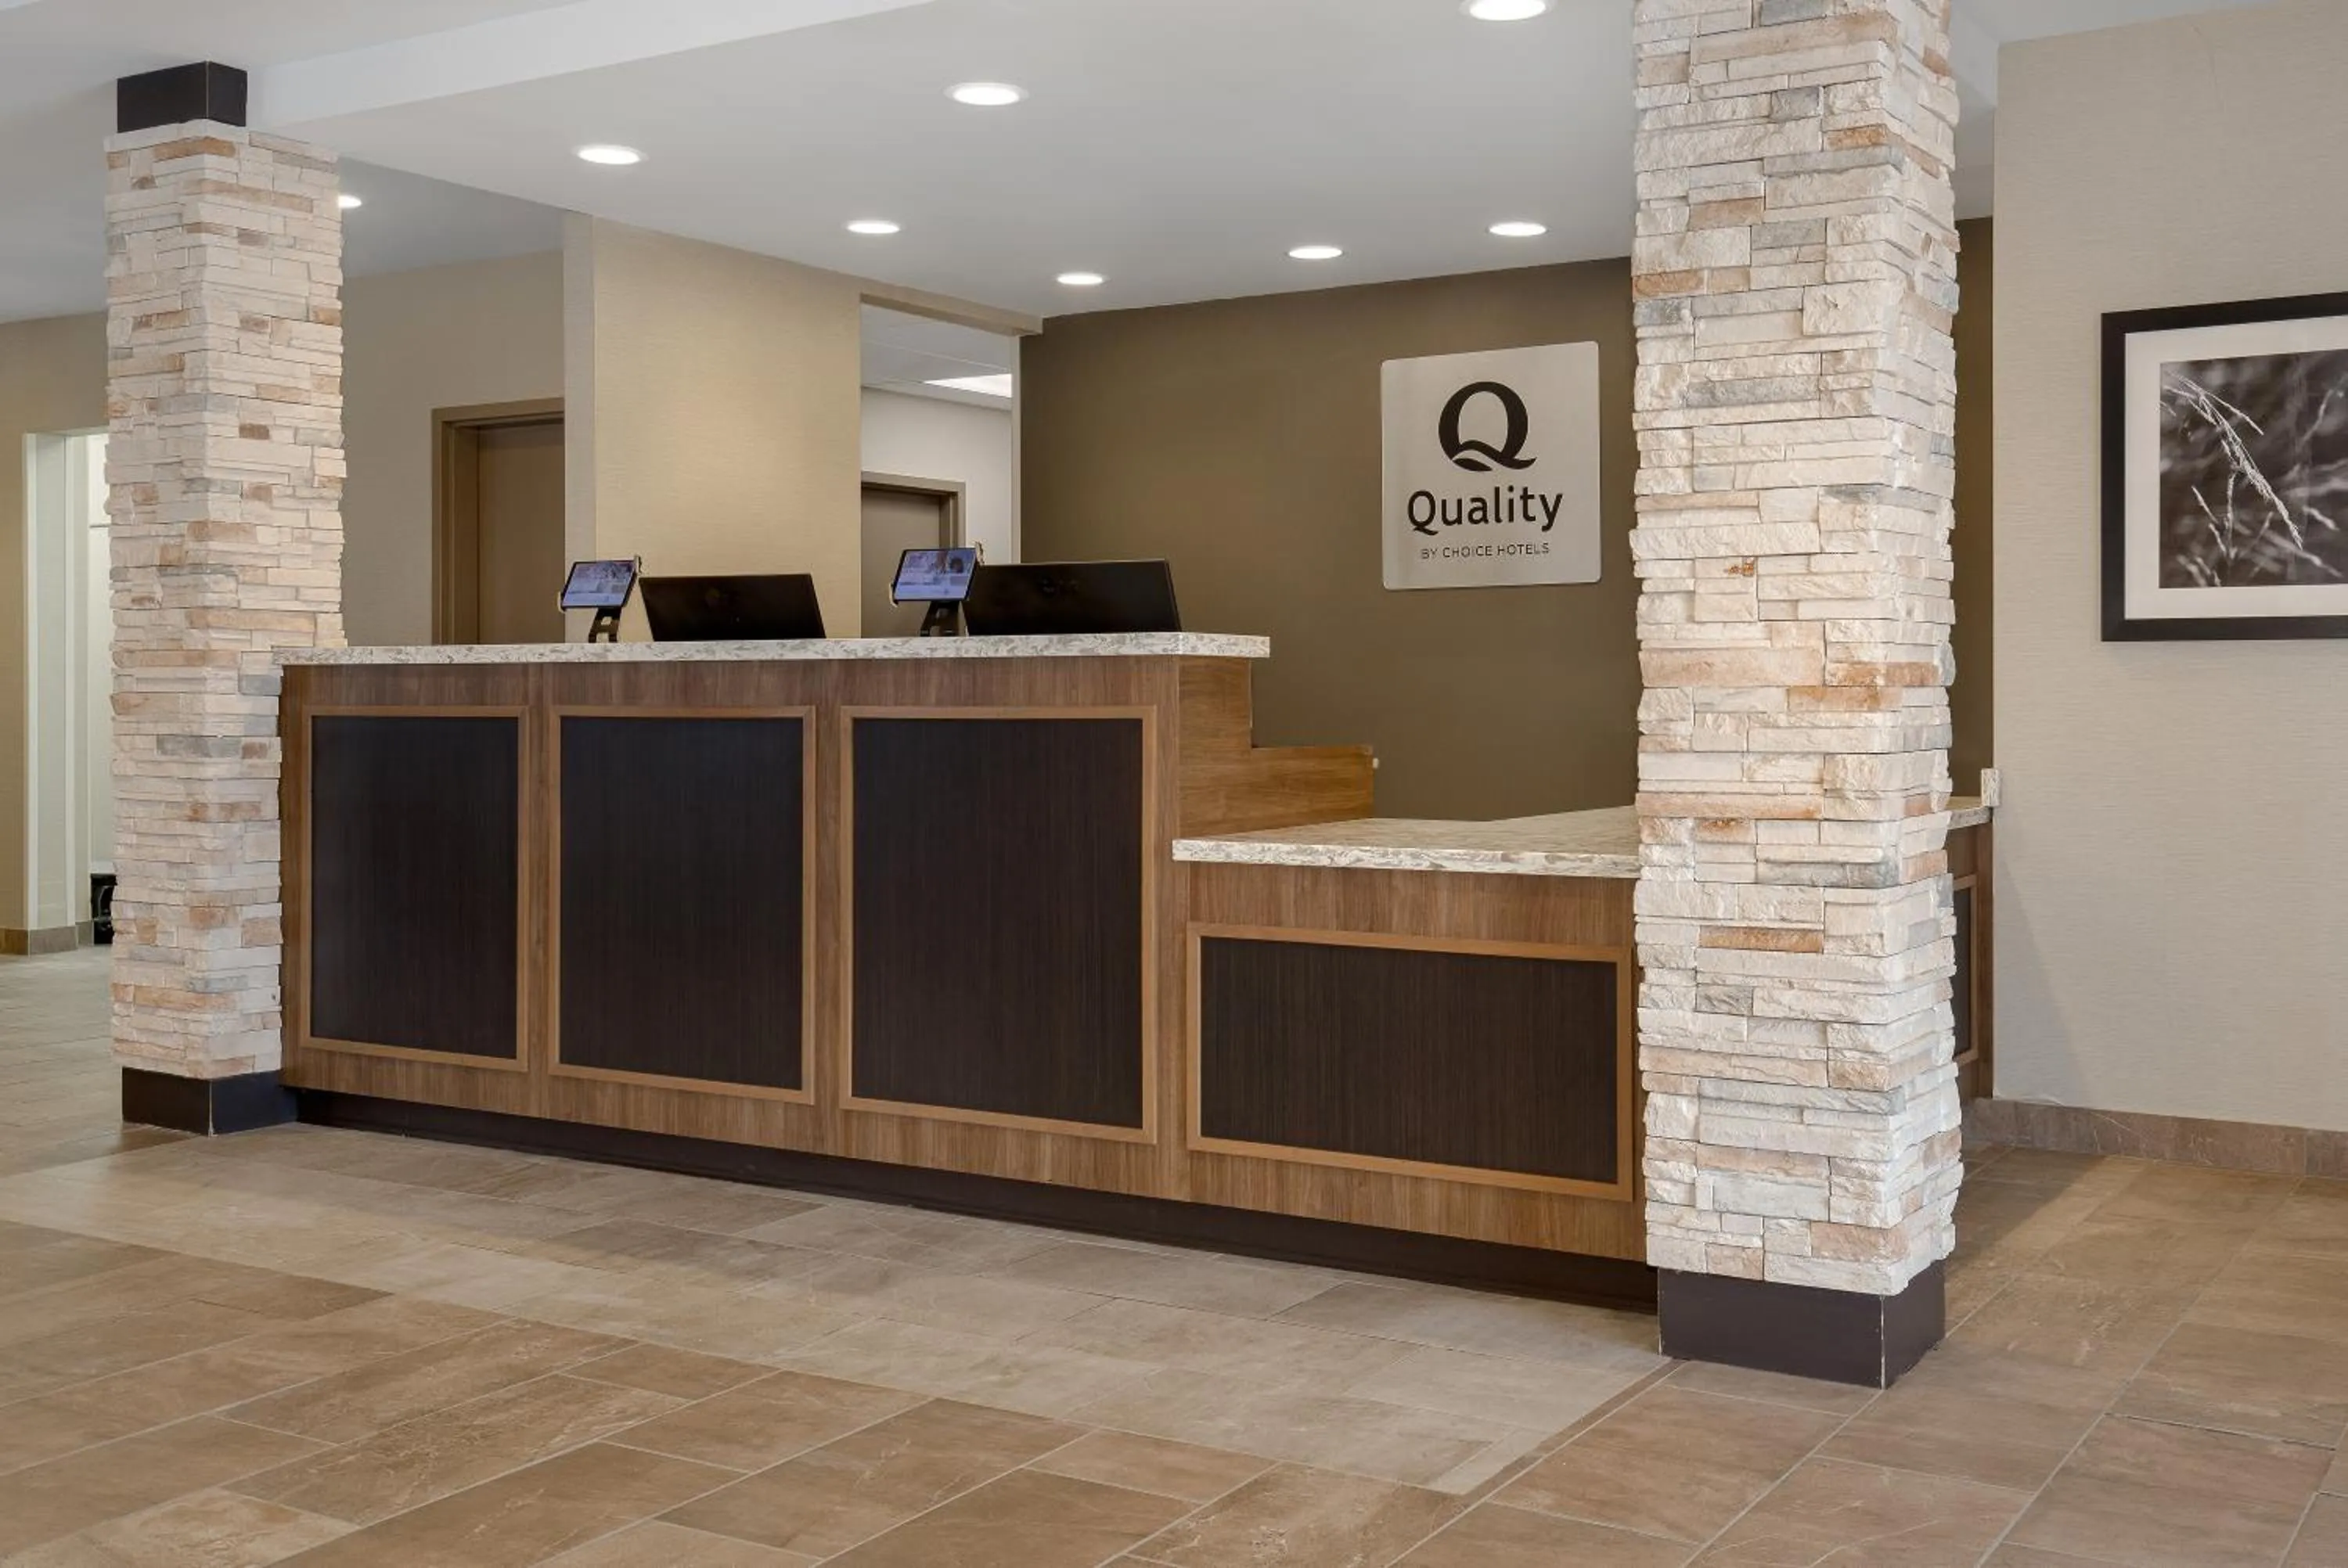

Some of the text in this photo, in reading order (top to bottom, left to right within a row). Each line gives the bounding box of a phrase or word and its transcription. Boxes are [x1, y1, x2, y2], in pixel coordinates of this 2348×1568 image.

[1439, 381, 1538, 472] Q
[1407, 485, 1564, 536] Quality
[1421, 542, 1550, 559] BY CHOICE HOTELS
